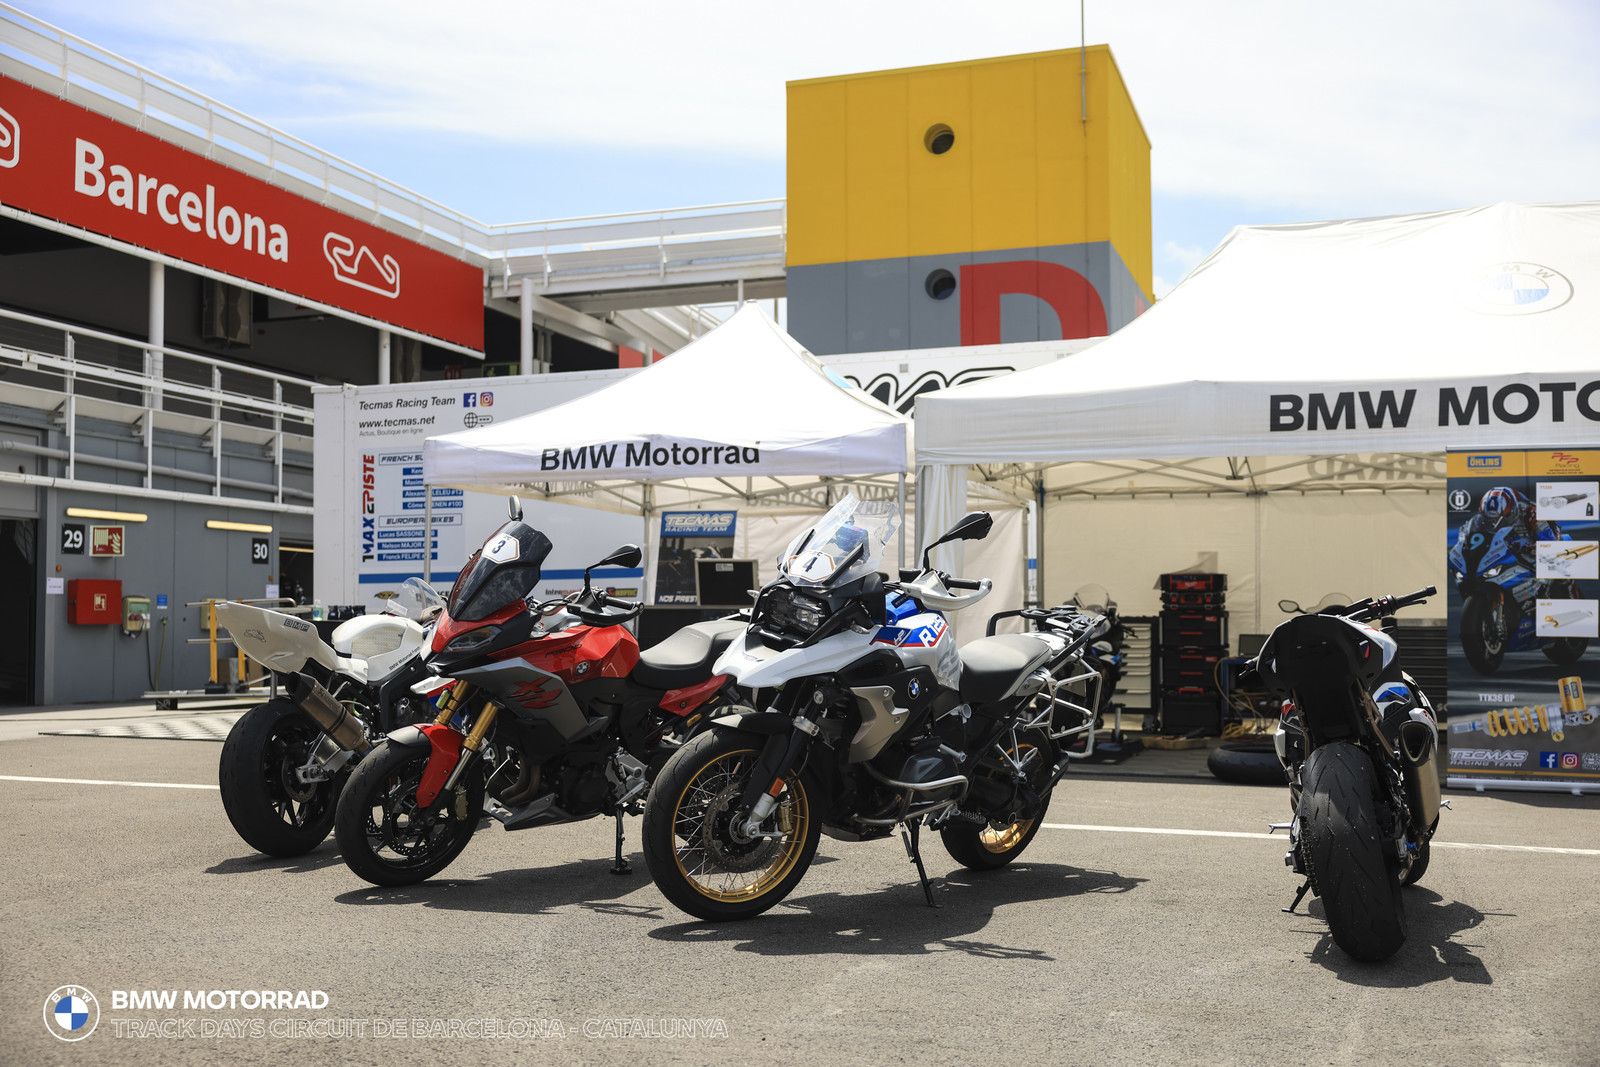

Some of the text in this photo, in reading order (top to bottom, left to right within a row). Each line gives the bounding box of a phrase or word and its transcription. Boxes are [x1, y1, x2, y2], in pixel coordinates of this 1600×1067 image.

[74, 137, 289, 263] Barcelona
[359, 396, 456, 410] Tecmas Racing Team
[1270, 389, 1417, 432] BMW
[359, 416, 435, 428] www.tecmas.net
[540, 441, 760, 471] BMW Motorrad
[1469, 457, 1500, 467] ÖHLINS
[665, 514, 734, 527] TECMAS
[64, 530, 83, 549] 29
[396, 530, 424, 538] SASSONE
[1470, 533, 1485, 550] 9
[254, 543, 268, 559] 30
[492, 540, 506, 554] 3
[803, 556, 818, 573] 4
[1504, 694, 1515, 702] GP
[1450, 748, 1528, 763] TECMAS
